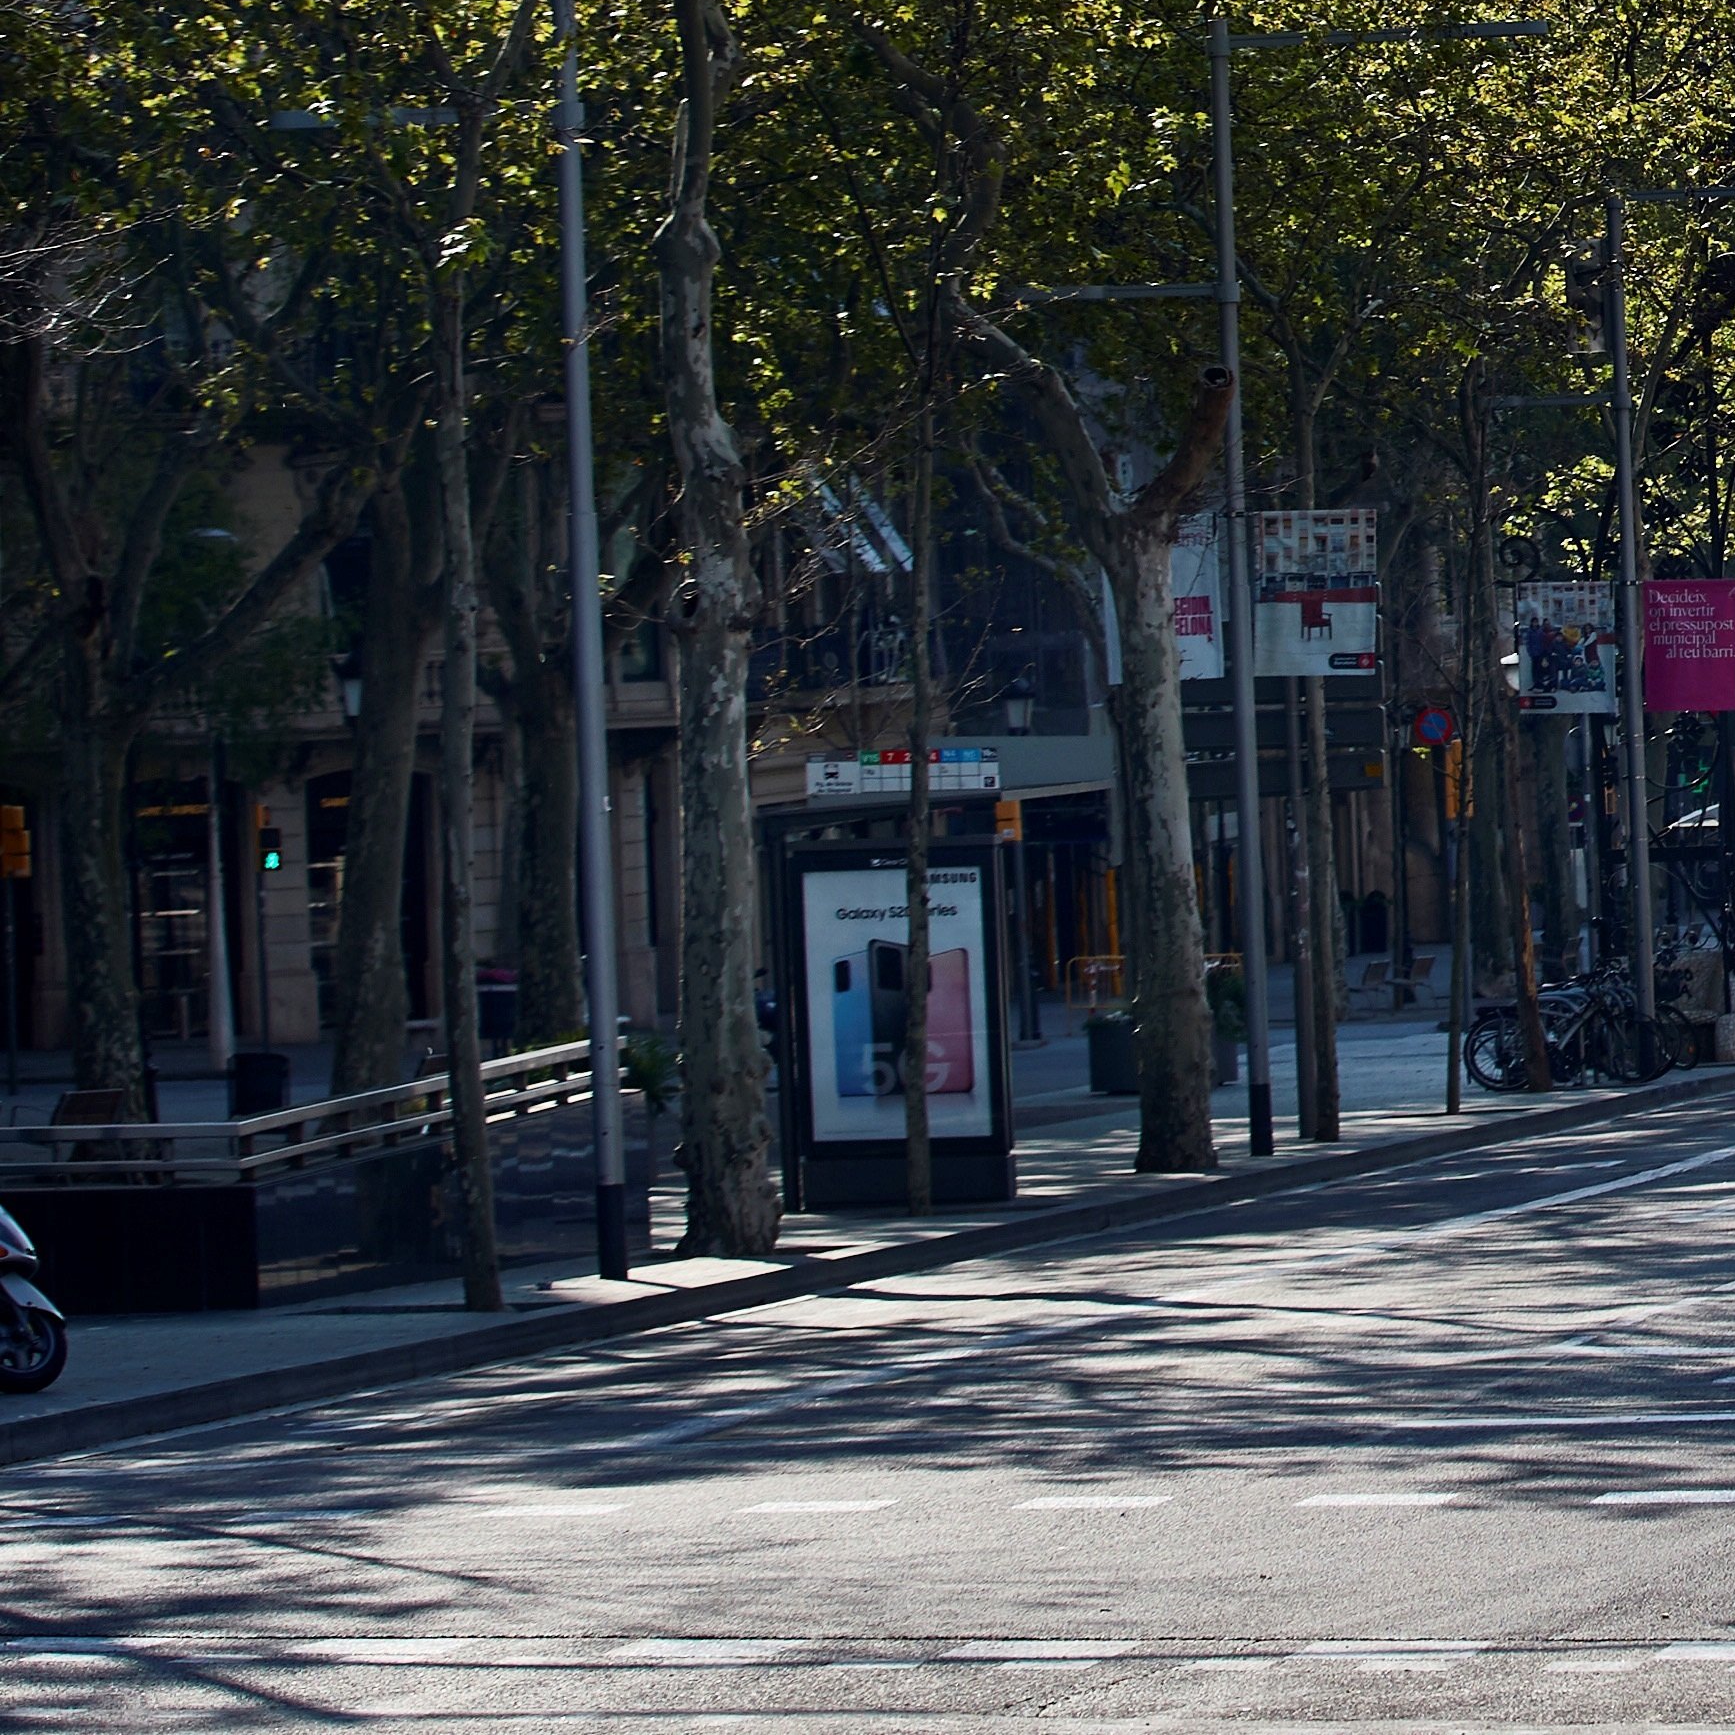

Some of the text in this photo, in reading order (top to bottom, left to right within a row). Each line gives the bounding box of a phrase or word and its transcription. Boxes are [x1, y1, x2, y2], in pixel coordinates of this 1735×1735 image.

[1648, 588, 1707, 604] Decideix
[1649, 603, 1716, 617] on invertir
[1649, 617, 1735, 635] el pressupost
[1653, 630, 1716, 647] municipal
[1665, 645, 1677, 659] al
[1679, 647, 1700, 659] teu
[886, 751, 896, 762] 7
[835, 907, 887, 922] Galaxy
[862, 1040, 952, 1096] 5G
